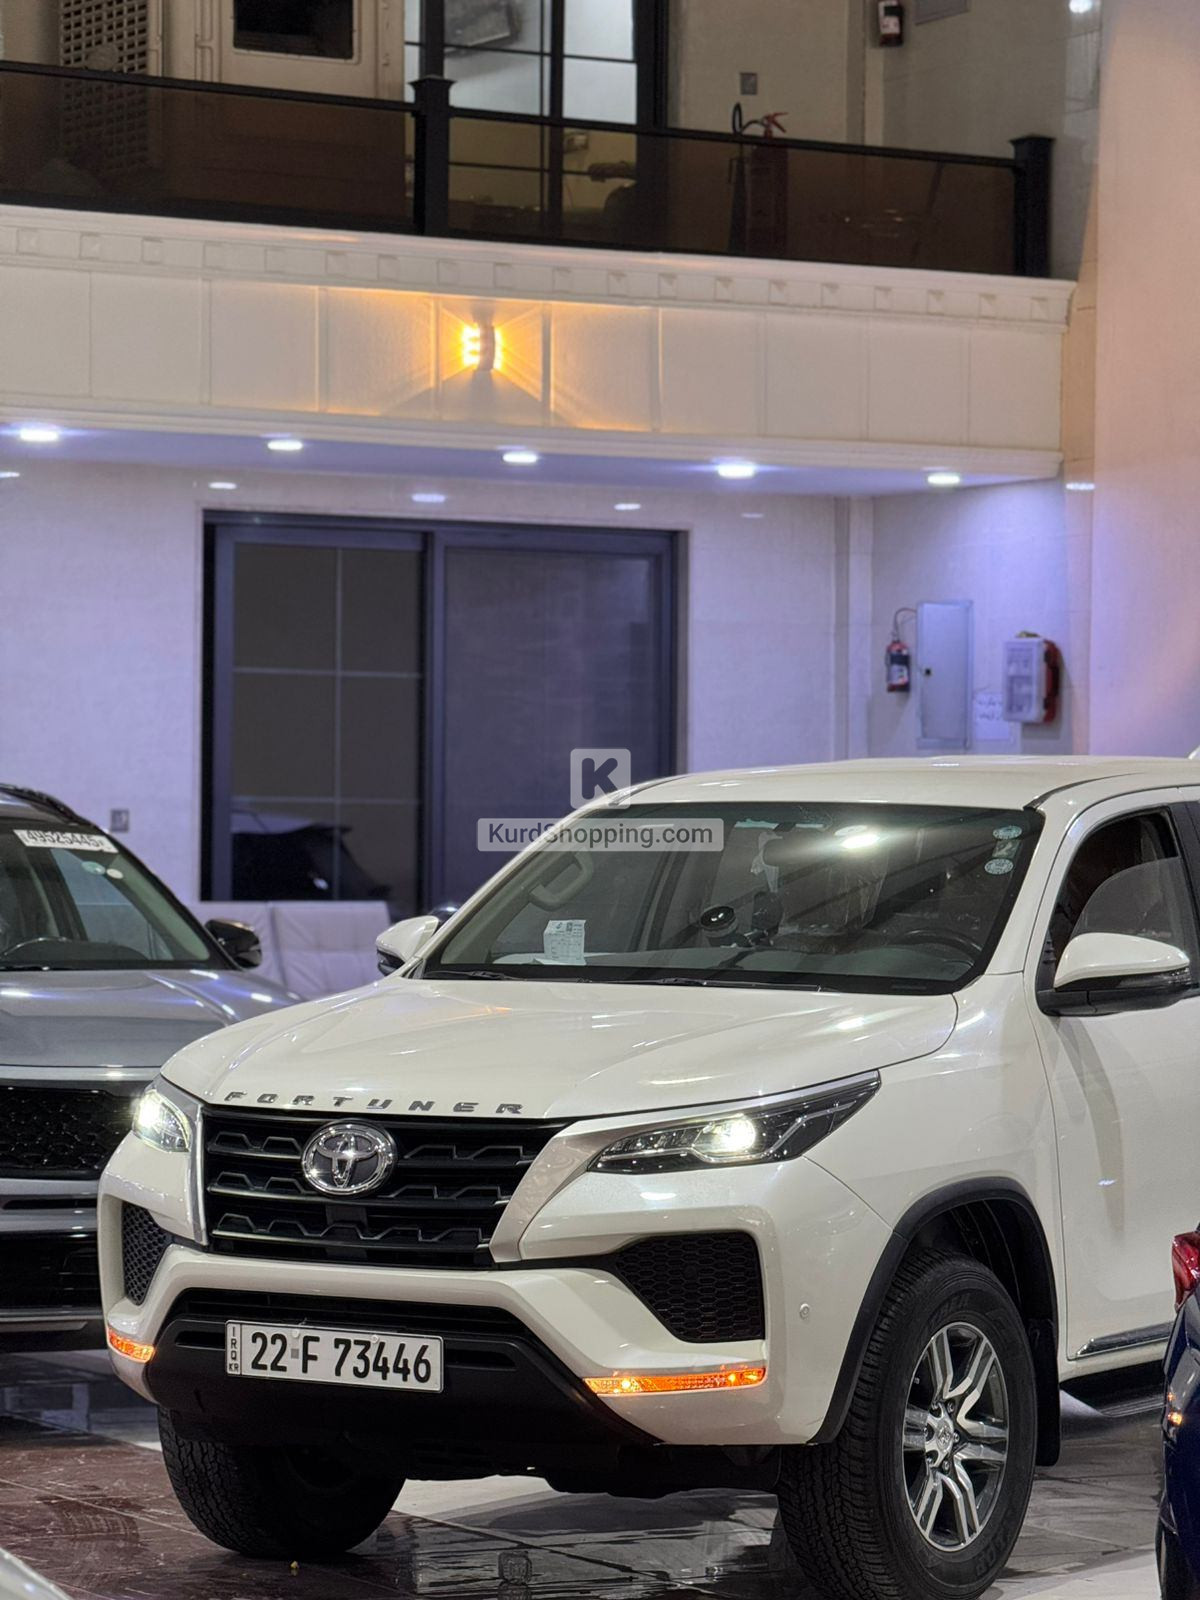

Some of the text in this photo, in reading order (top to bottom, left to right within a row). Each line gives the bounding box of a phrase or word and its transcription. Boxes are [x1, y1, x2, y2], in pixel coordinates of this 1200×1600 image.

[224, 1090, 525, 1115] FORTUNER
[250, 1331, 432, 1384] 22 F 73446
